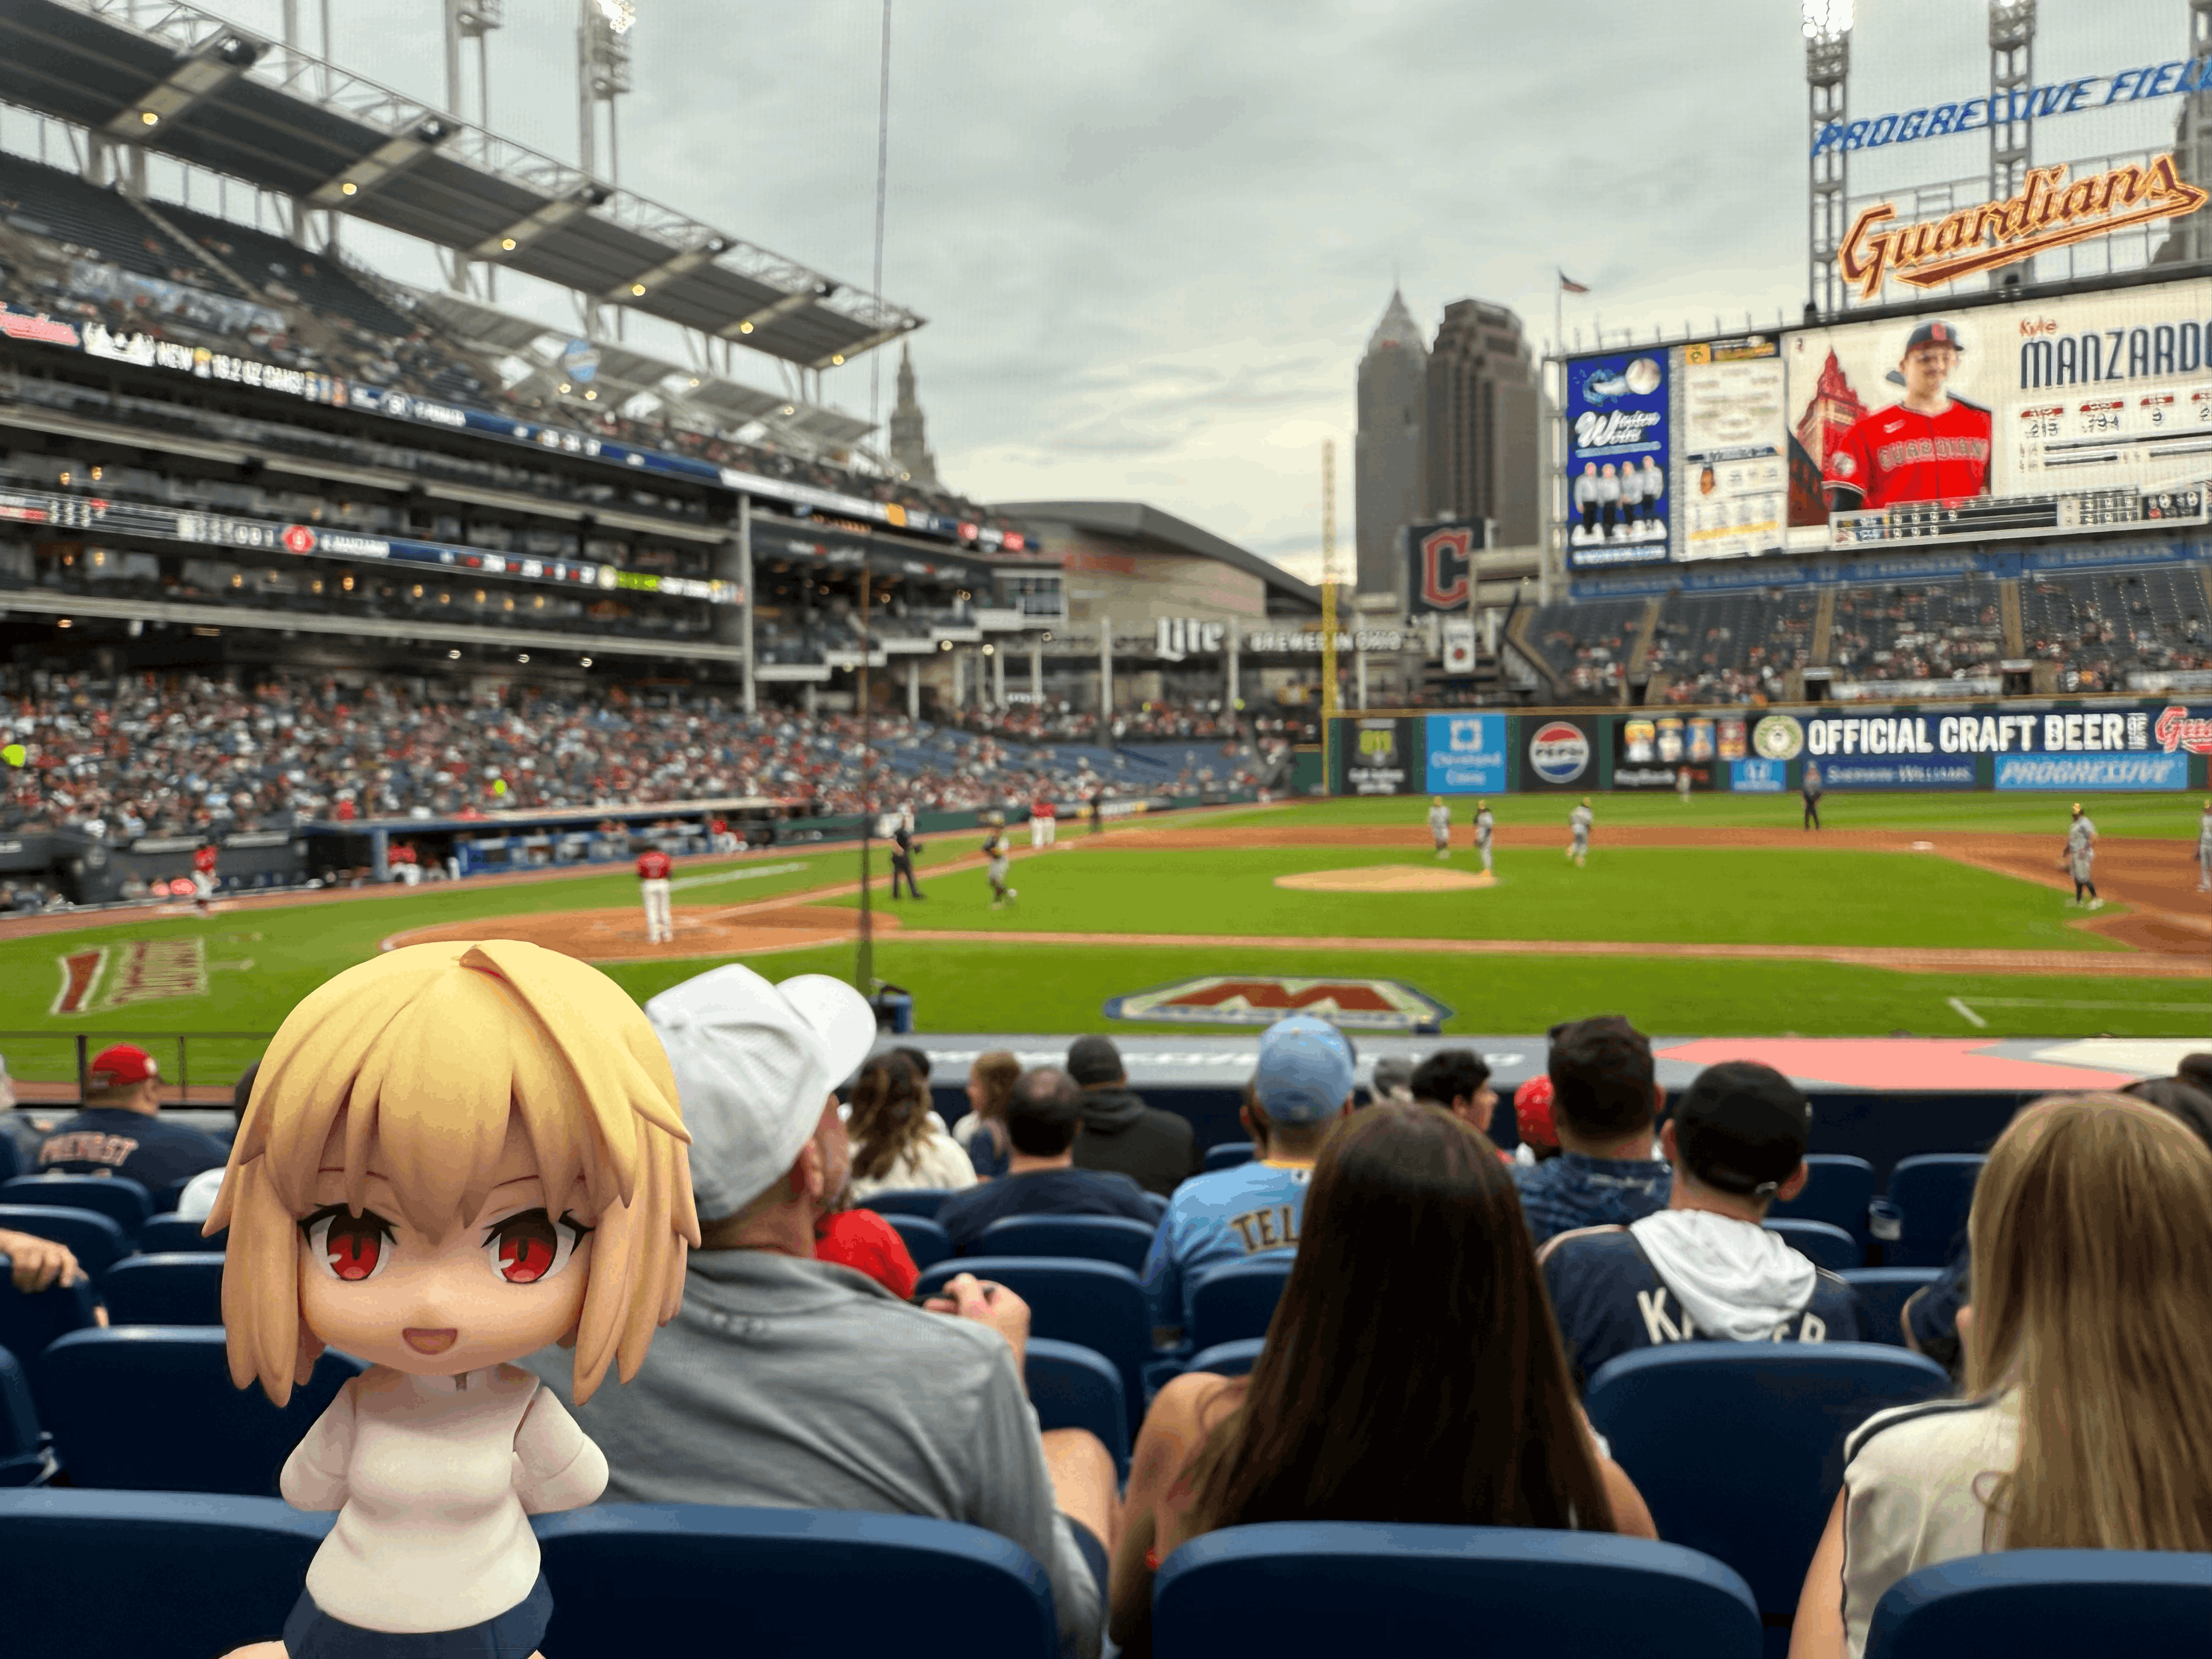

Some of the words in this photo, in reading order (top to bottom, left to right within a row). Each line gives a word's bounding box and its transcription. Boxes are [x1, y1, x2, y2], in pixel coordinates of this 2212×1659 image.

[1812, 76, 2098, 156] PROGRESSIVE
[1838, 153, 2209, 300] Guardians
[1422, 528, 1472, 608] C
[1808, 719, 1934, 755] OFFICIAL
[1939, 715, 2038, 753] CRAFT
[2045, 714, 2124, 751] BEER
